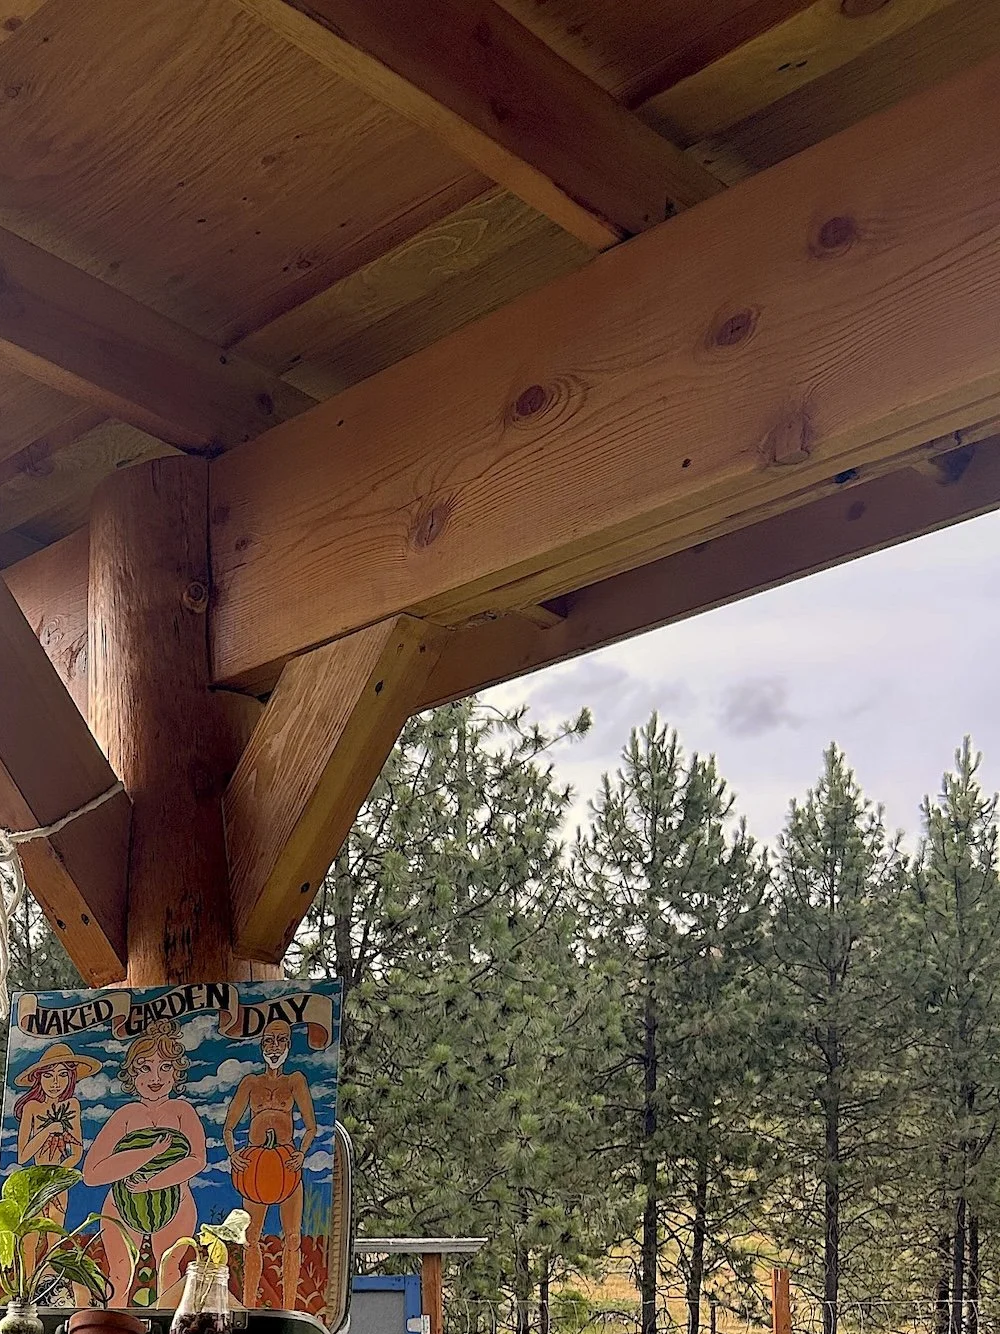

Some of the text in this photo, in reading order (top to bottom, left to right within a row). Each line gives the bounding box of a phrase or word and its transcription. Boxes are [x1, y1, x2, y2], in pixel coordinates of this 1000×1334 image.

[27, 983, 312, 1037] NAKED GARDEN DAY
